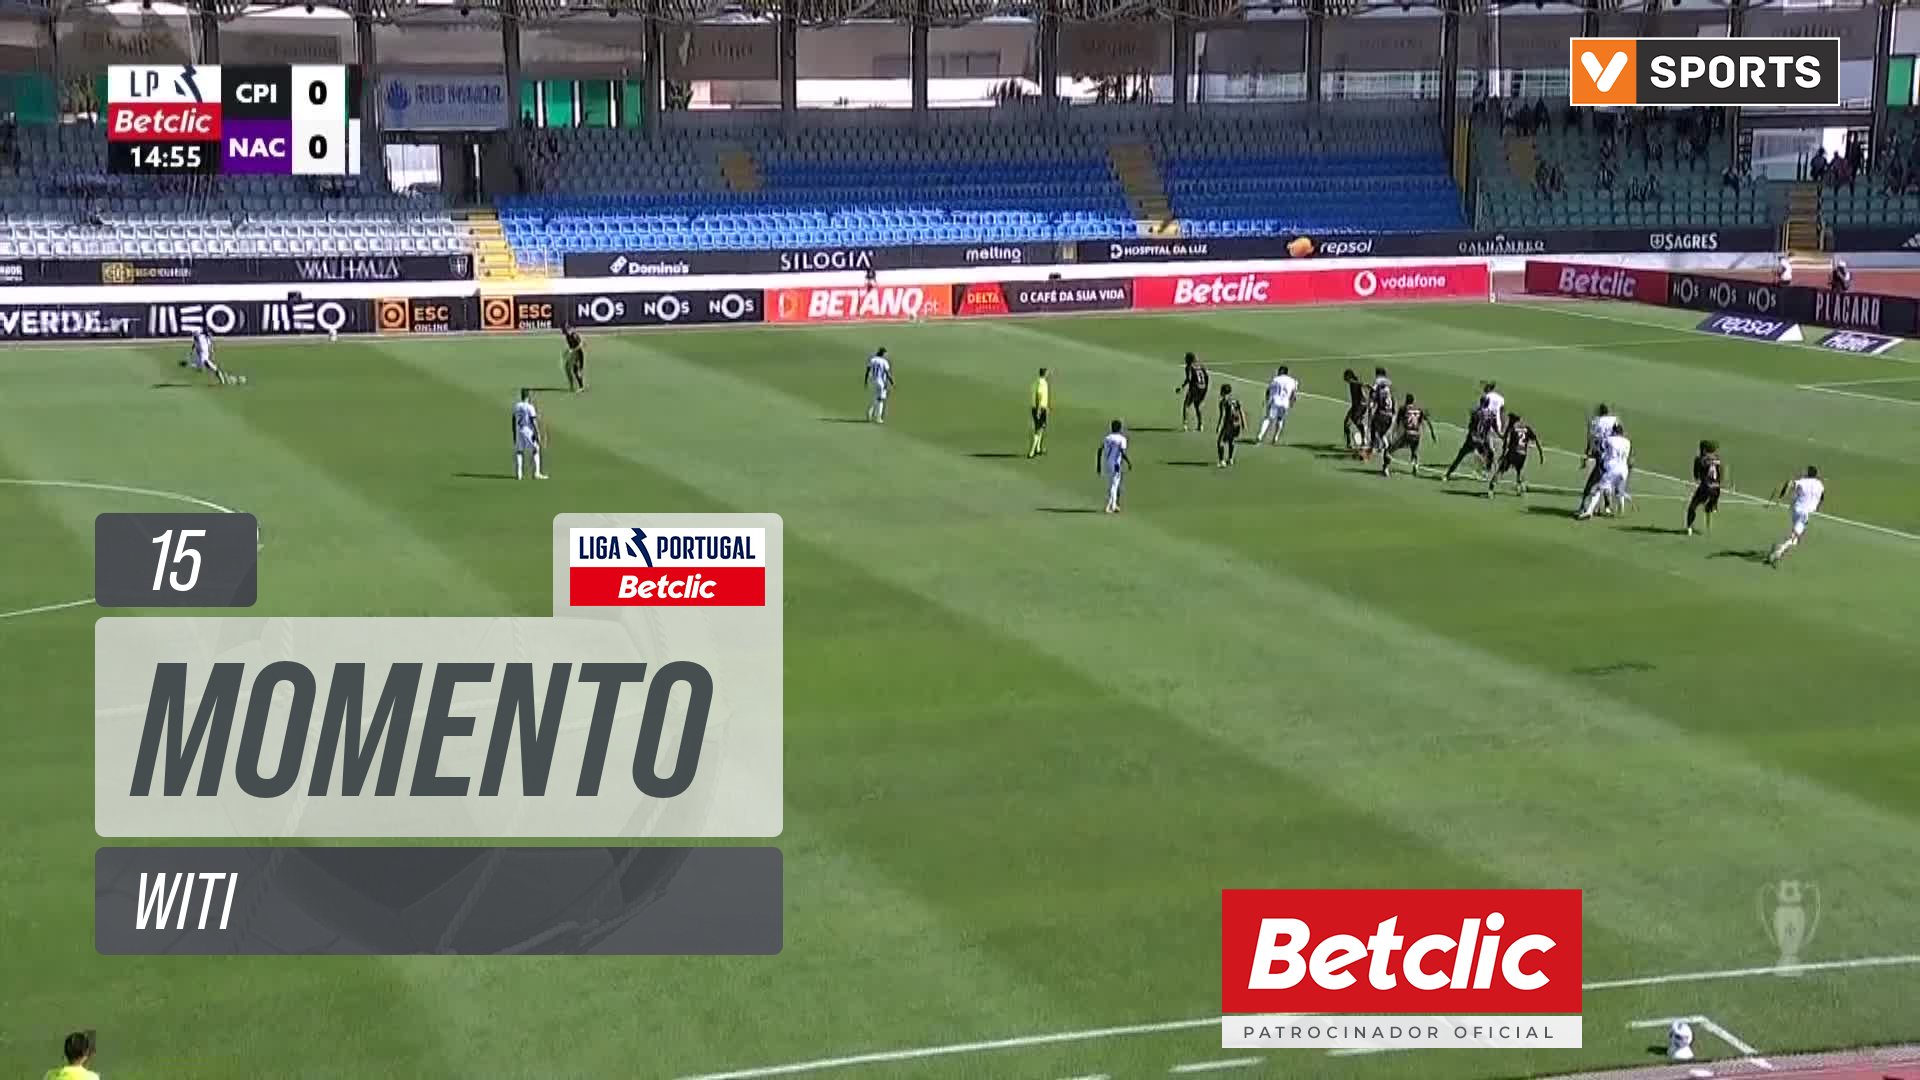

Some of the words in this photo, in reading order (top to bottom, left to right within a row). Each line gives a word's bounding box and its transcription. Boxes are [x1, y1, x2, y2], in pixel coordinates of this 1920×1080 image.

[1320, 240, 1373, 255] repsol
[1665, 232, 1718, 250] SAGRES
[1124, 245, 1171, 256] HOSPITAL
[1173, 245, 1187, 255] DA
[1189, 244, 1208, 254] LUZ
[628, 261, 690, 275] Domino's
[780, 252, 871, 271] SILOGIA
[1380, 273, 1446, 289] vodafone
[1558, 267, 1637, 298] Betclic
[1020, 291, 1029, 303] O
[1030, 289, 1057, 303] CAFÉ
[1060, 290, 1074, 302] DA
[1076, 290, 1098, 301] SUA
[1099, 288, 1125, 300] VIDA
[1173, 273, 1270, 305] Betclic
[1672, 278, 1699, 303] NOS
[1709, 282, 1737, 308] NOS
[1748, 286, 1776, 312] NOS
[967, 291, 1000, 304] DELTA
[414, 306, 449, 321] ESC
[519, 304, 552, 319] ESC
[577, 296, 624, 322] NOS
[644, 295, 690, 321] NOS
[709, 293, 754, 319] NOS
[414, 323, 449, 332] ONLINE
